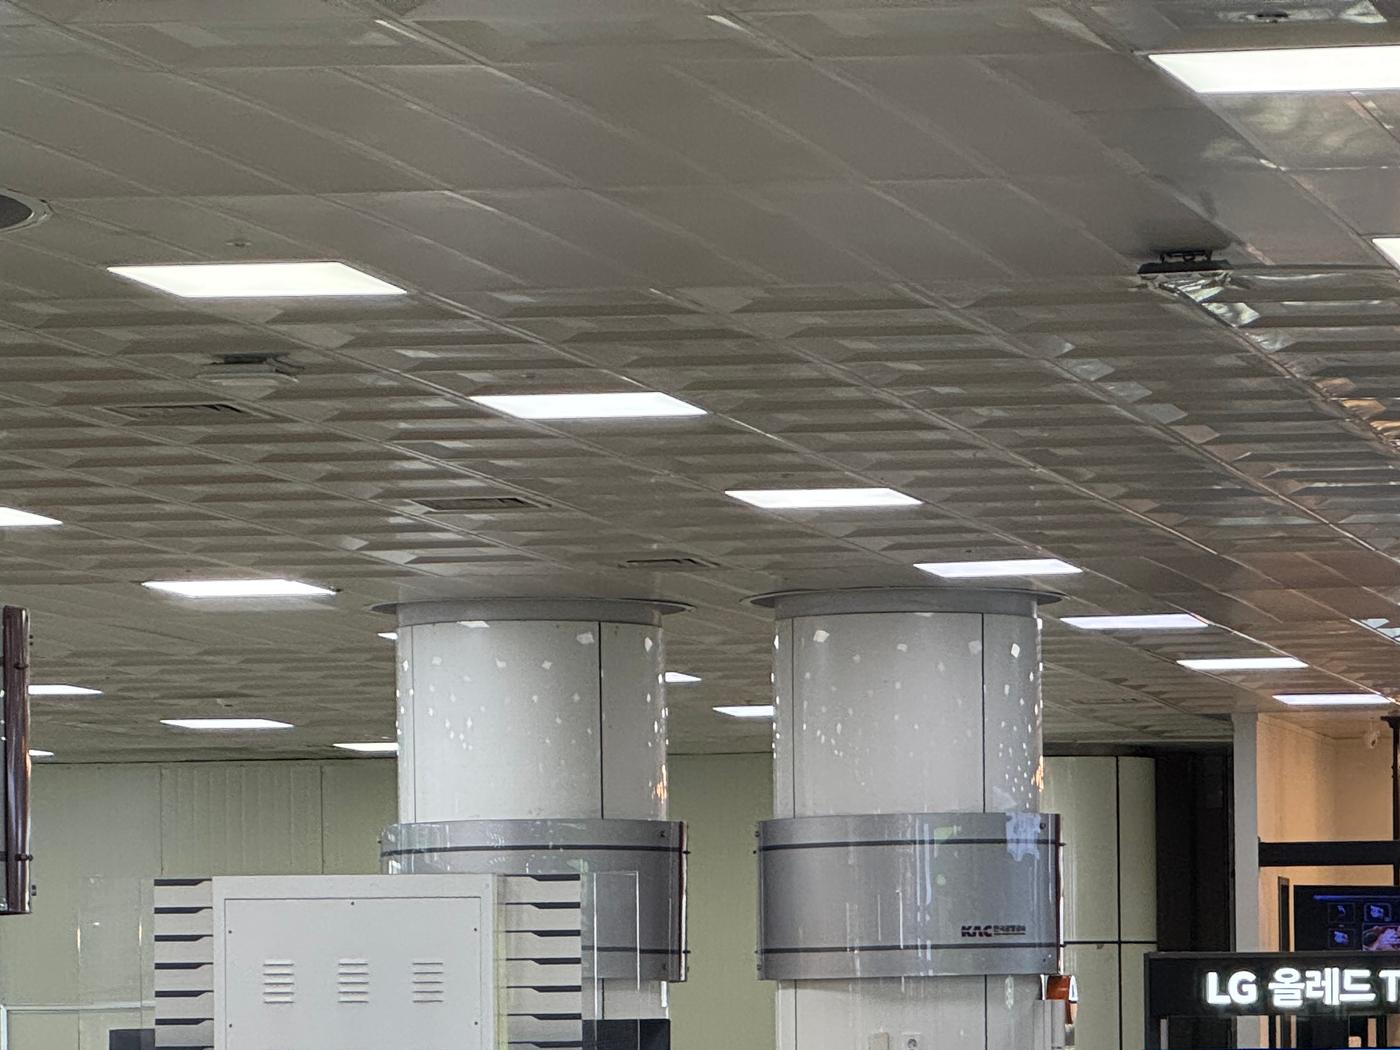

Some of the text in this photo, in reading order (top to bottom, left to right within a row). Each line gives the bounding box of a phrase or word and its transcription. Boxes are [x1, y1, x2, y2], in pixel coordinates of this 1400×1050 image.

[962, 925, 992, 937] KAC
[1206, 970, 1258, 1004] LG
[1268, 967, 1377, 1008] 올레드
